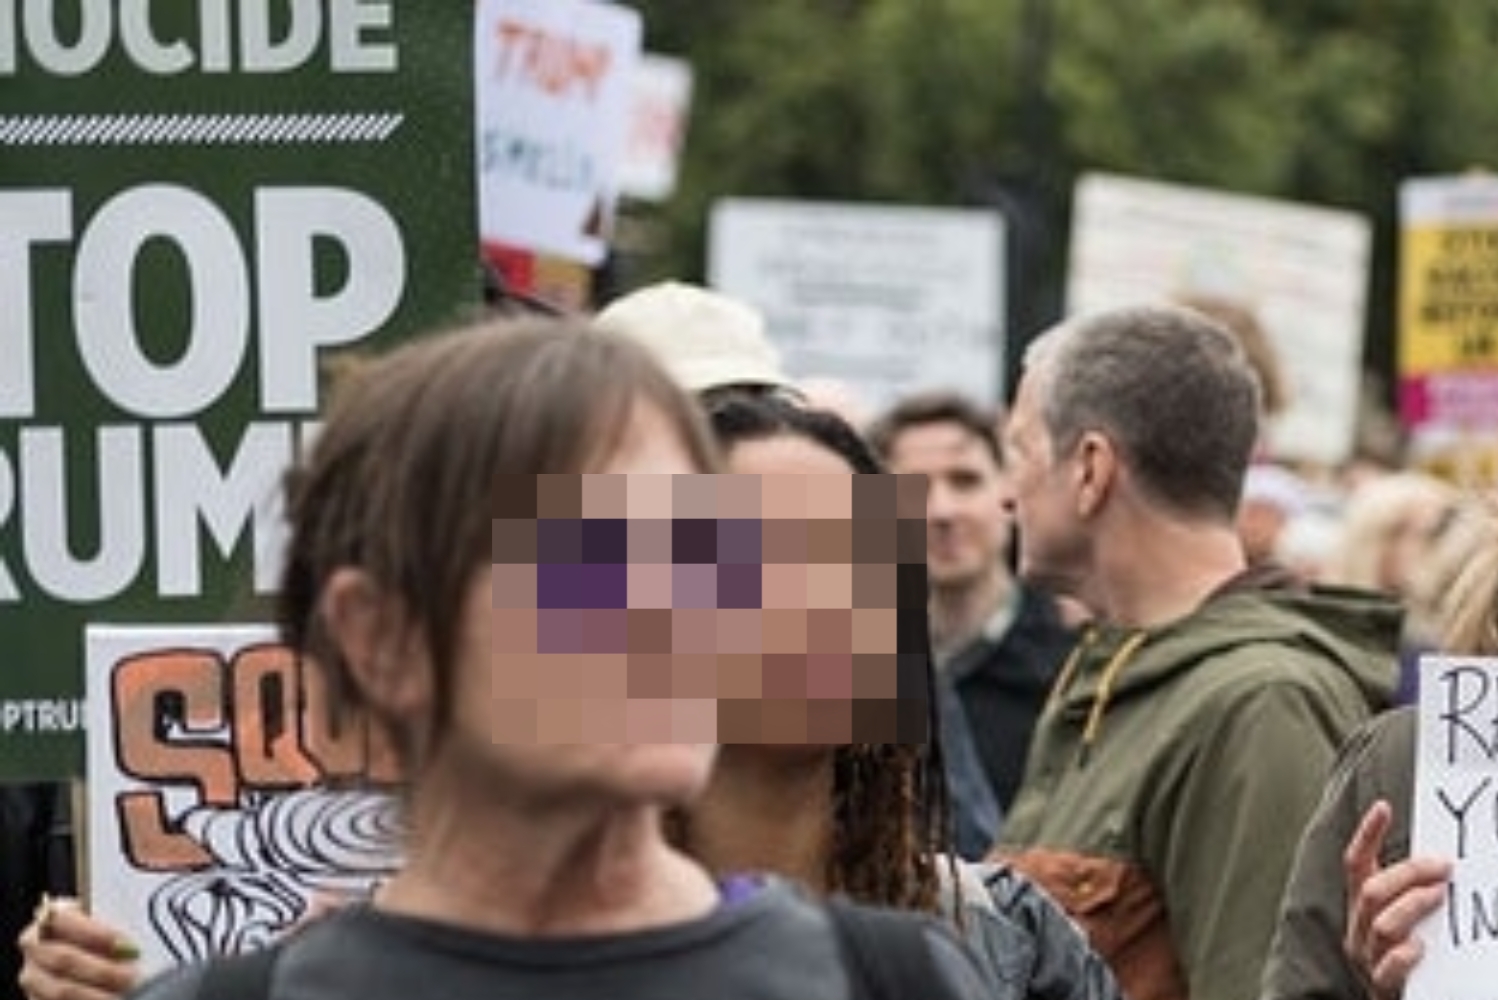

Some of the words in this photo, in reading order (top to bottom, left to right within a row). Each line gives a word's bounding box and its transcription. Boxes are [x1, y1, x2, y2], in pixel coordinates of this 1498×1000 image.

[0, 0, 398, 76] OCIDE
[0, 420, 326, 602] UM
[0, 699, 87, 731] PTRU
[110, 641, 412, 873] SQU
